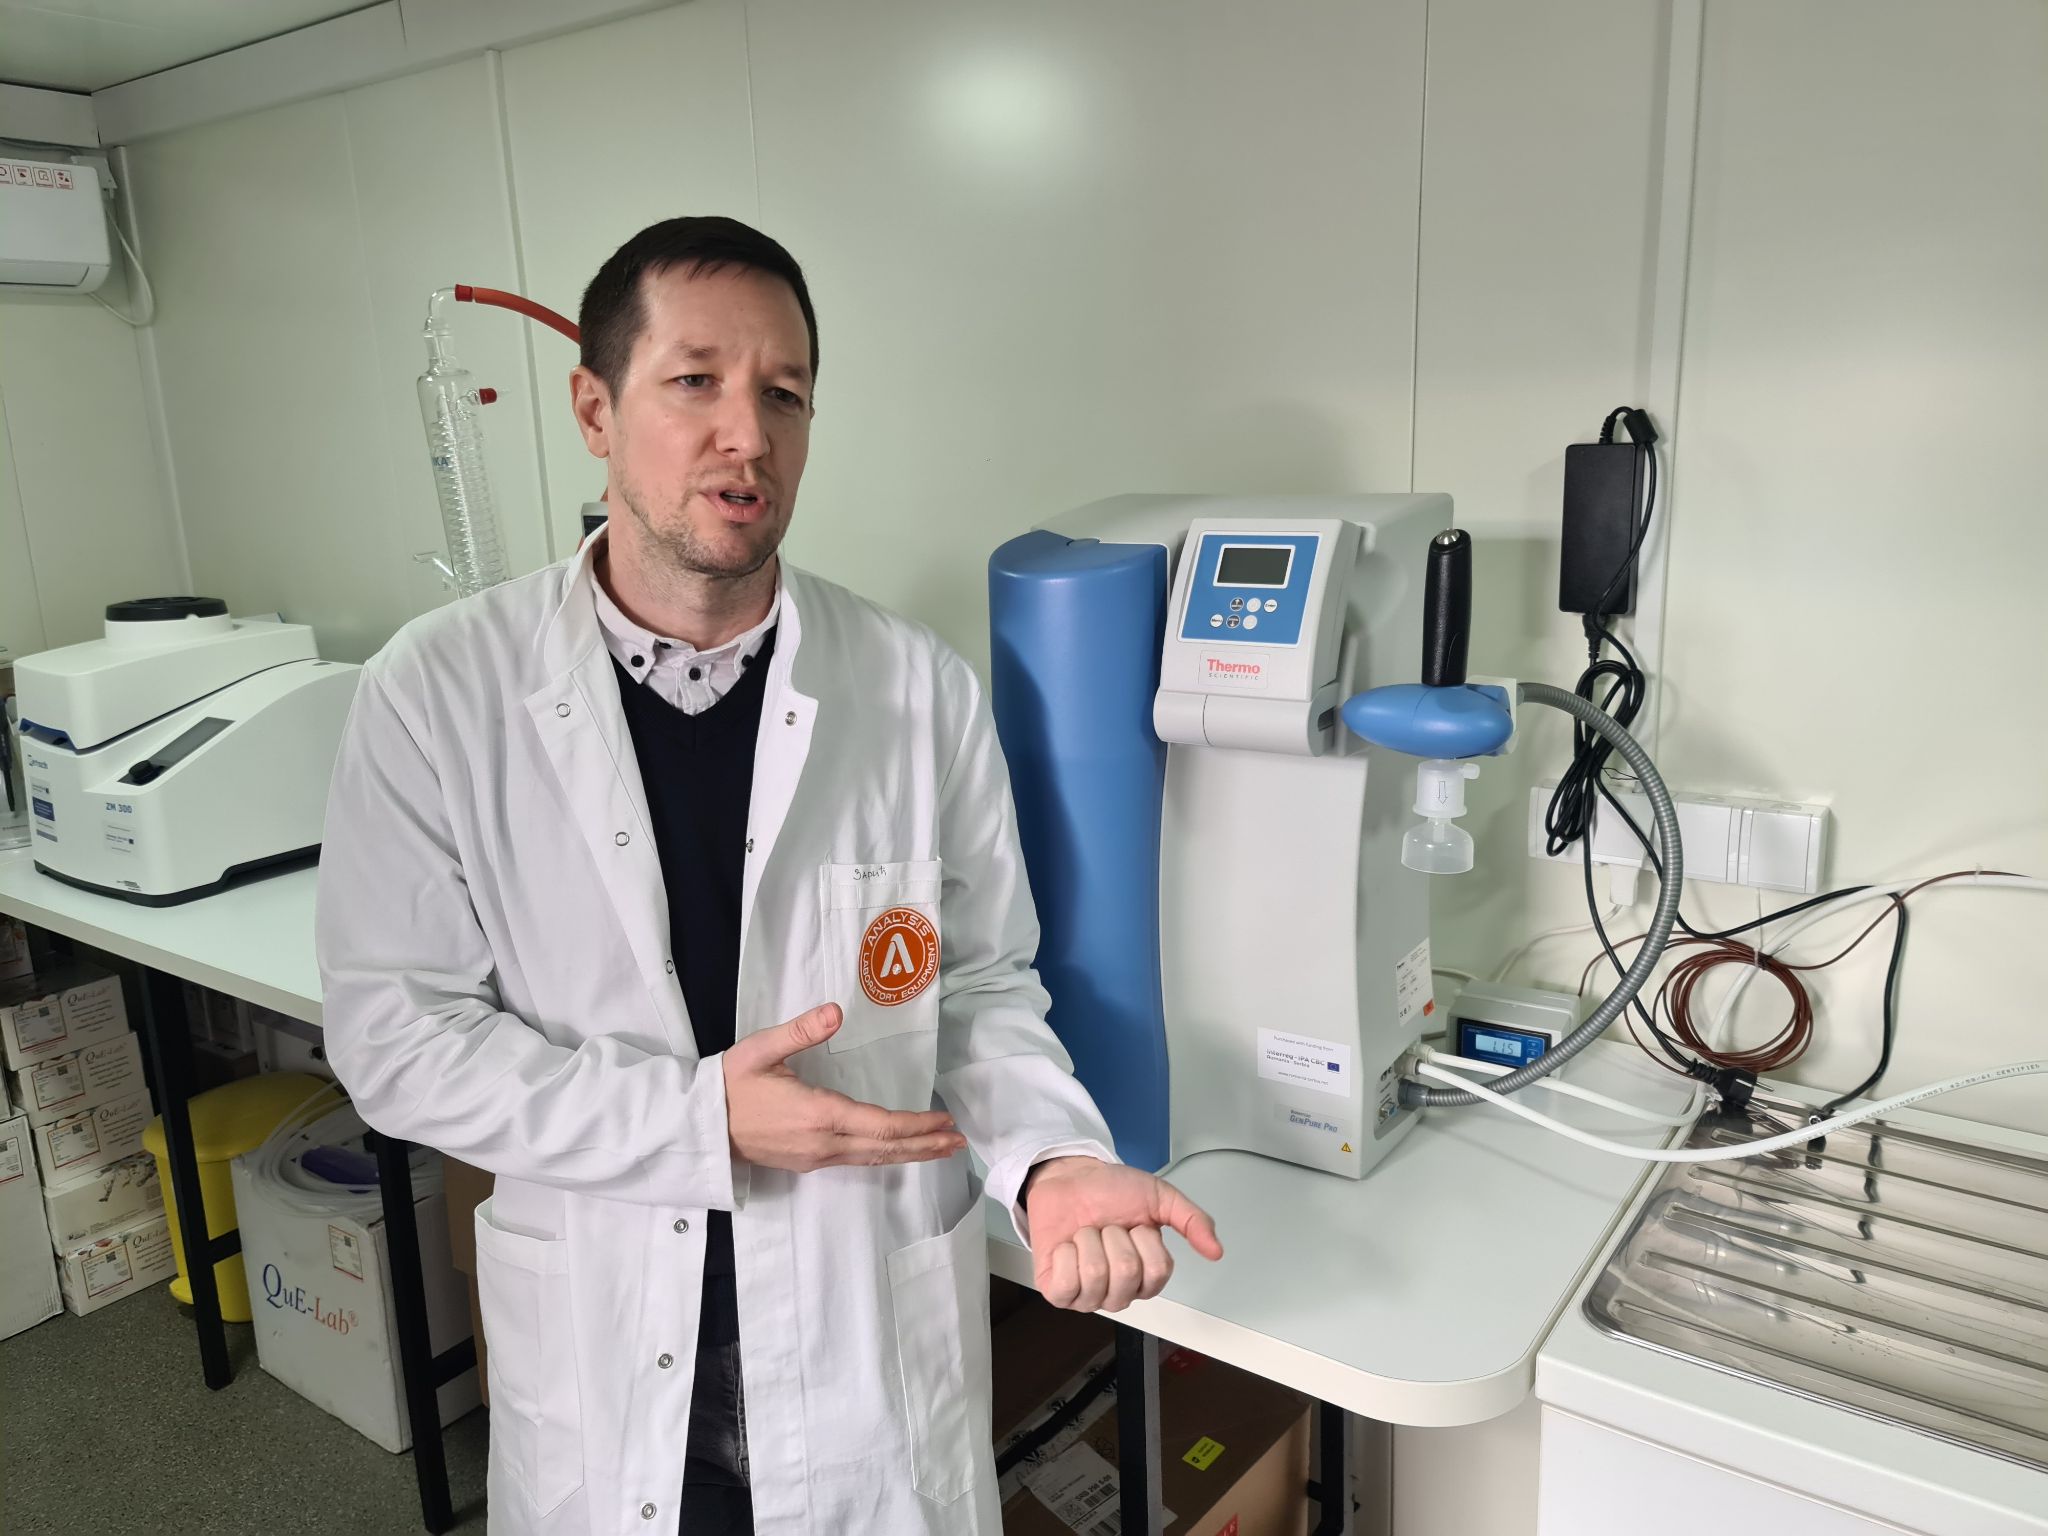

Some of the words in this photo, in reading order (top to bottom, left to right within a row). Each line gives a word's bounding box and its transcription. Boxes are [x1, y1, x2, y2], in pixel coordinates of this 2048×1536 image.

[1207, 658, 1261, 674] Thermo
[1208, 672, 1259, 680] SCIENTIFIC
[105, 802, 117, 811] ZM
[118, 803, 133, 813] 300
[867, 912, 931, 947] ANALYSIS
[863, 952, 898, 1002] LABORATORY
[901, 941, 937, 999] EQUIPMENT
[1266, 1048, 1294, 1060] Interreg
[1298, 1055, 1310, 1063] IPA
[1493, 1041, 1514, 1055] 1.15
